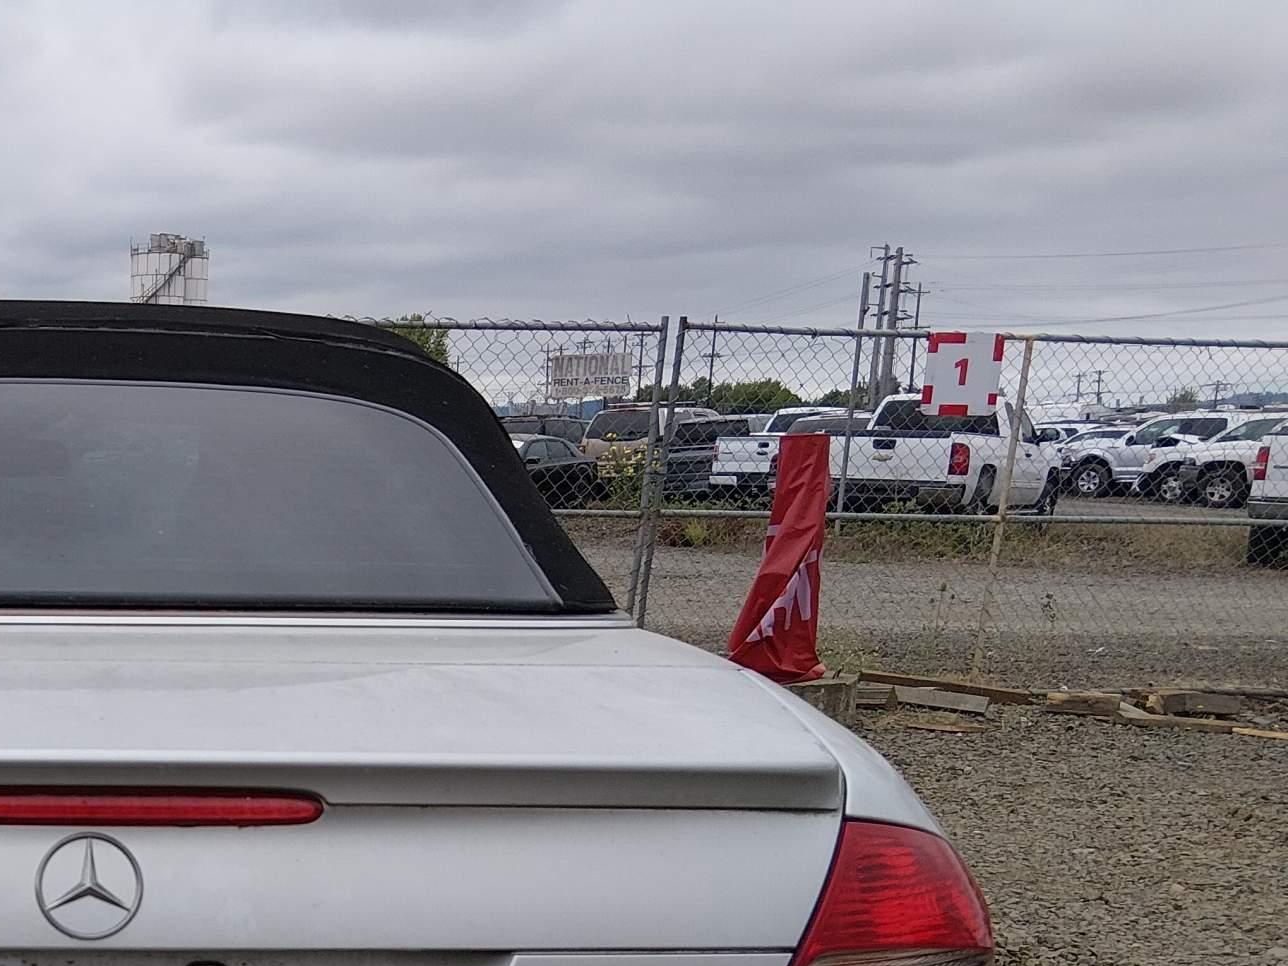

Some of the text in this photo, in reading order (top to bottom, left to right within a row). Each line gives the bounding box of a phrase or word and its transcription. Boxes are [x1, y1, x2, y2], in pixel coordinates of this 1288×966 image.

[553, 354, 629, 377] NATIONAL
[955, 358, 969, 385] 1
[553, 376, 628, 387] RENT-A-FENCE
